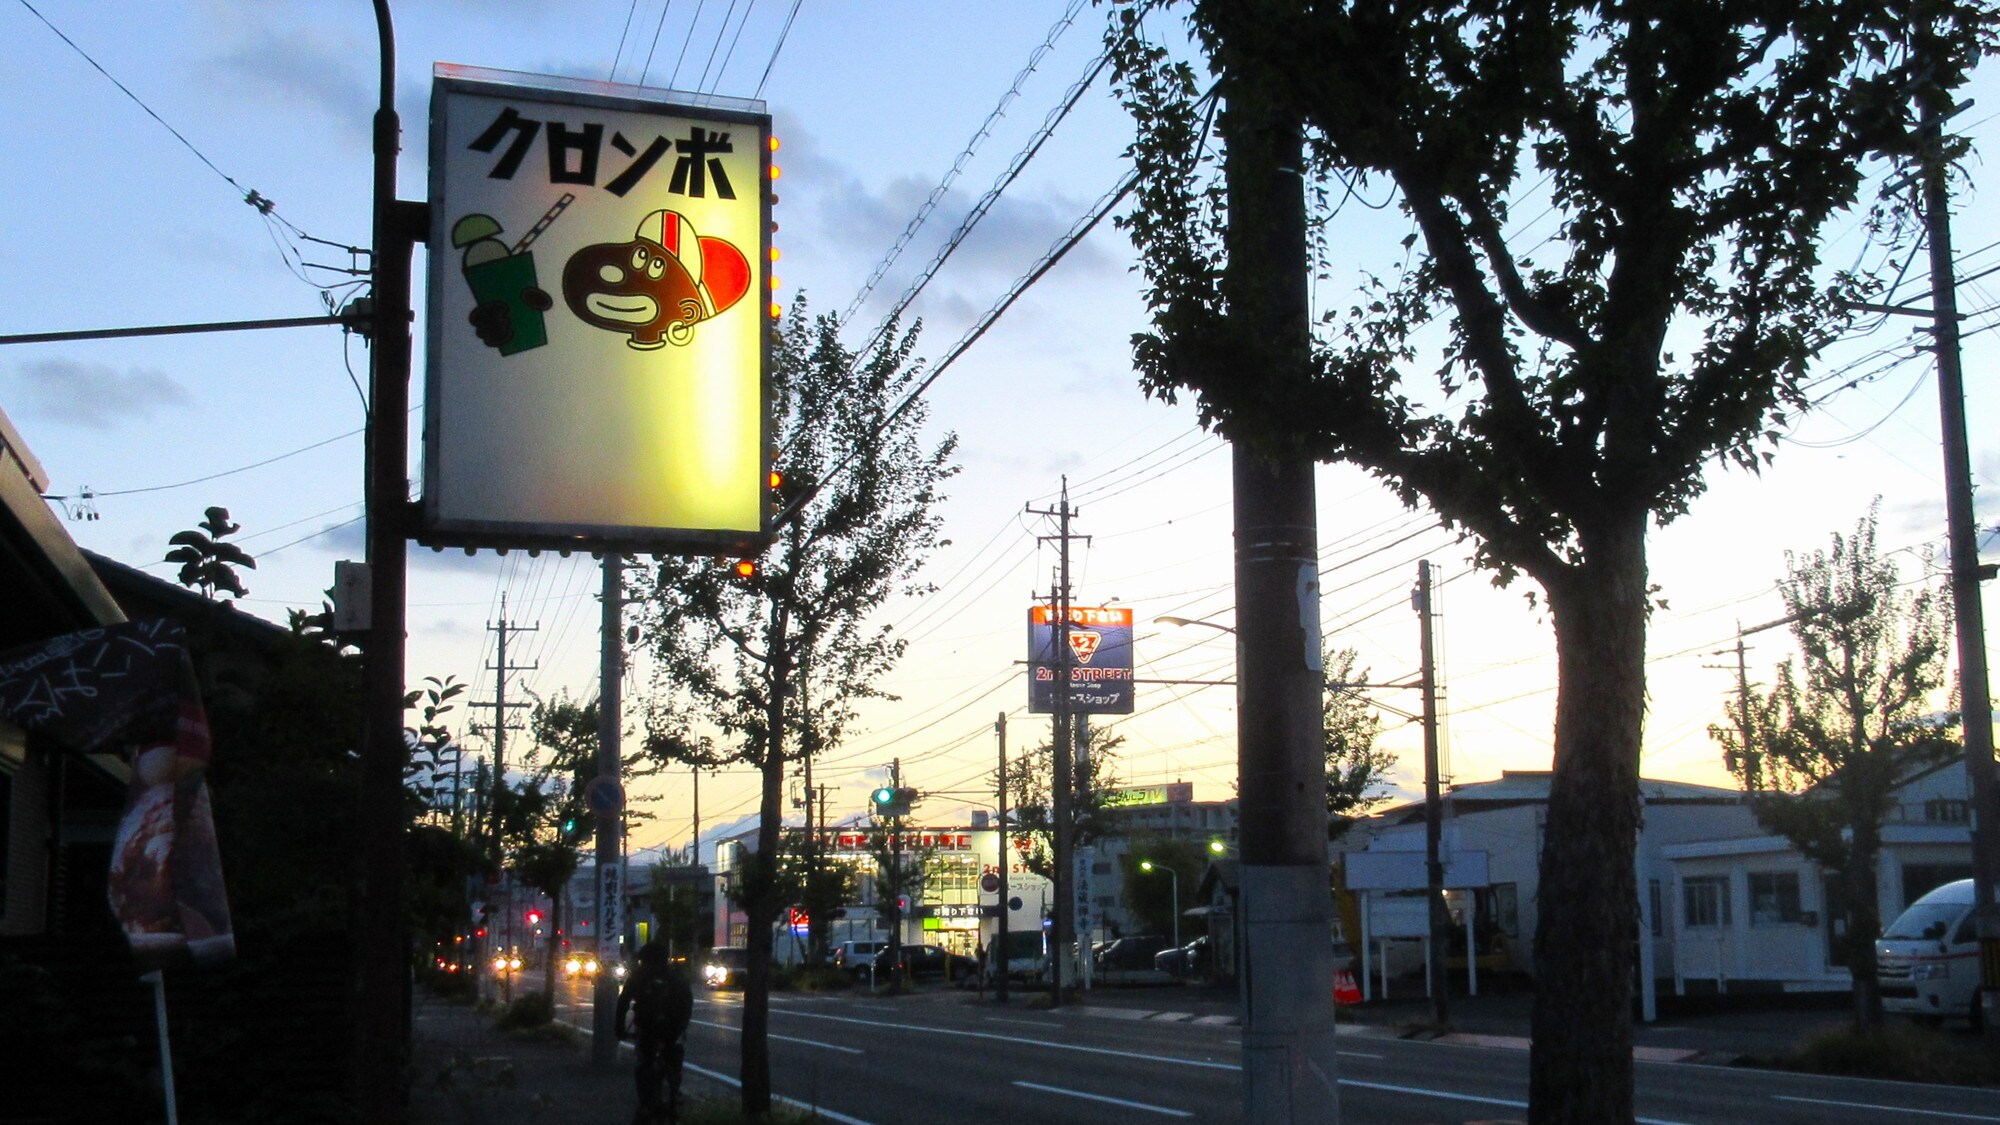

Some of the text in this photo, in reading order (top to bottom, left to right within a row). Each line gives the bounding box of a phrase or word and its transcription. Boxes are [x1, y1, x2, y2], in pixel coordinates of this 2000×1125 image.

[467, 106, 736, 200] クロンボ
[1071, 667, 1132, 682] STREET
